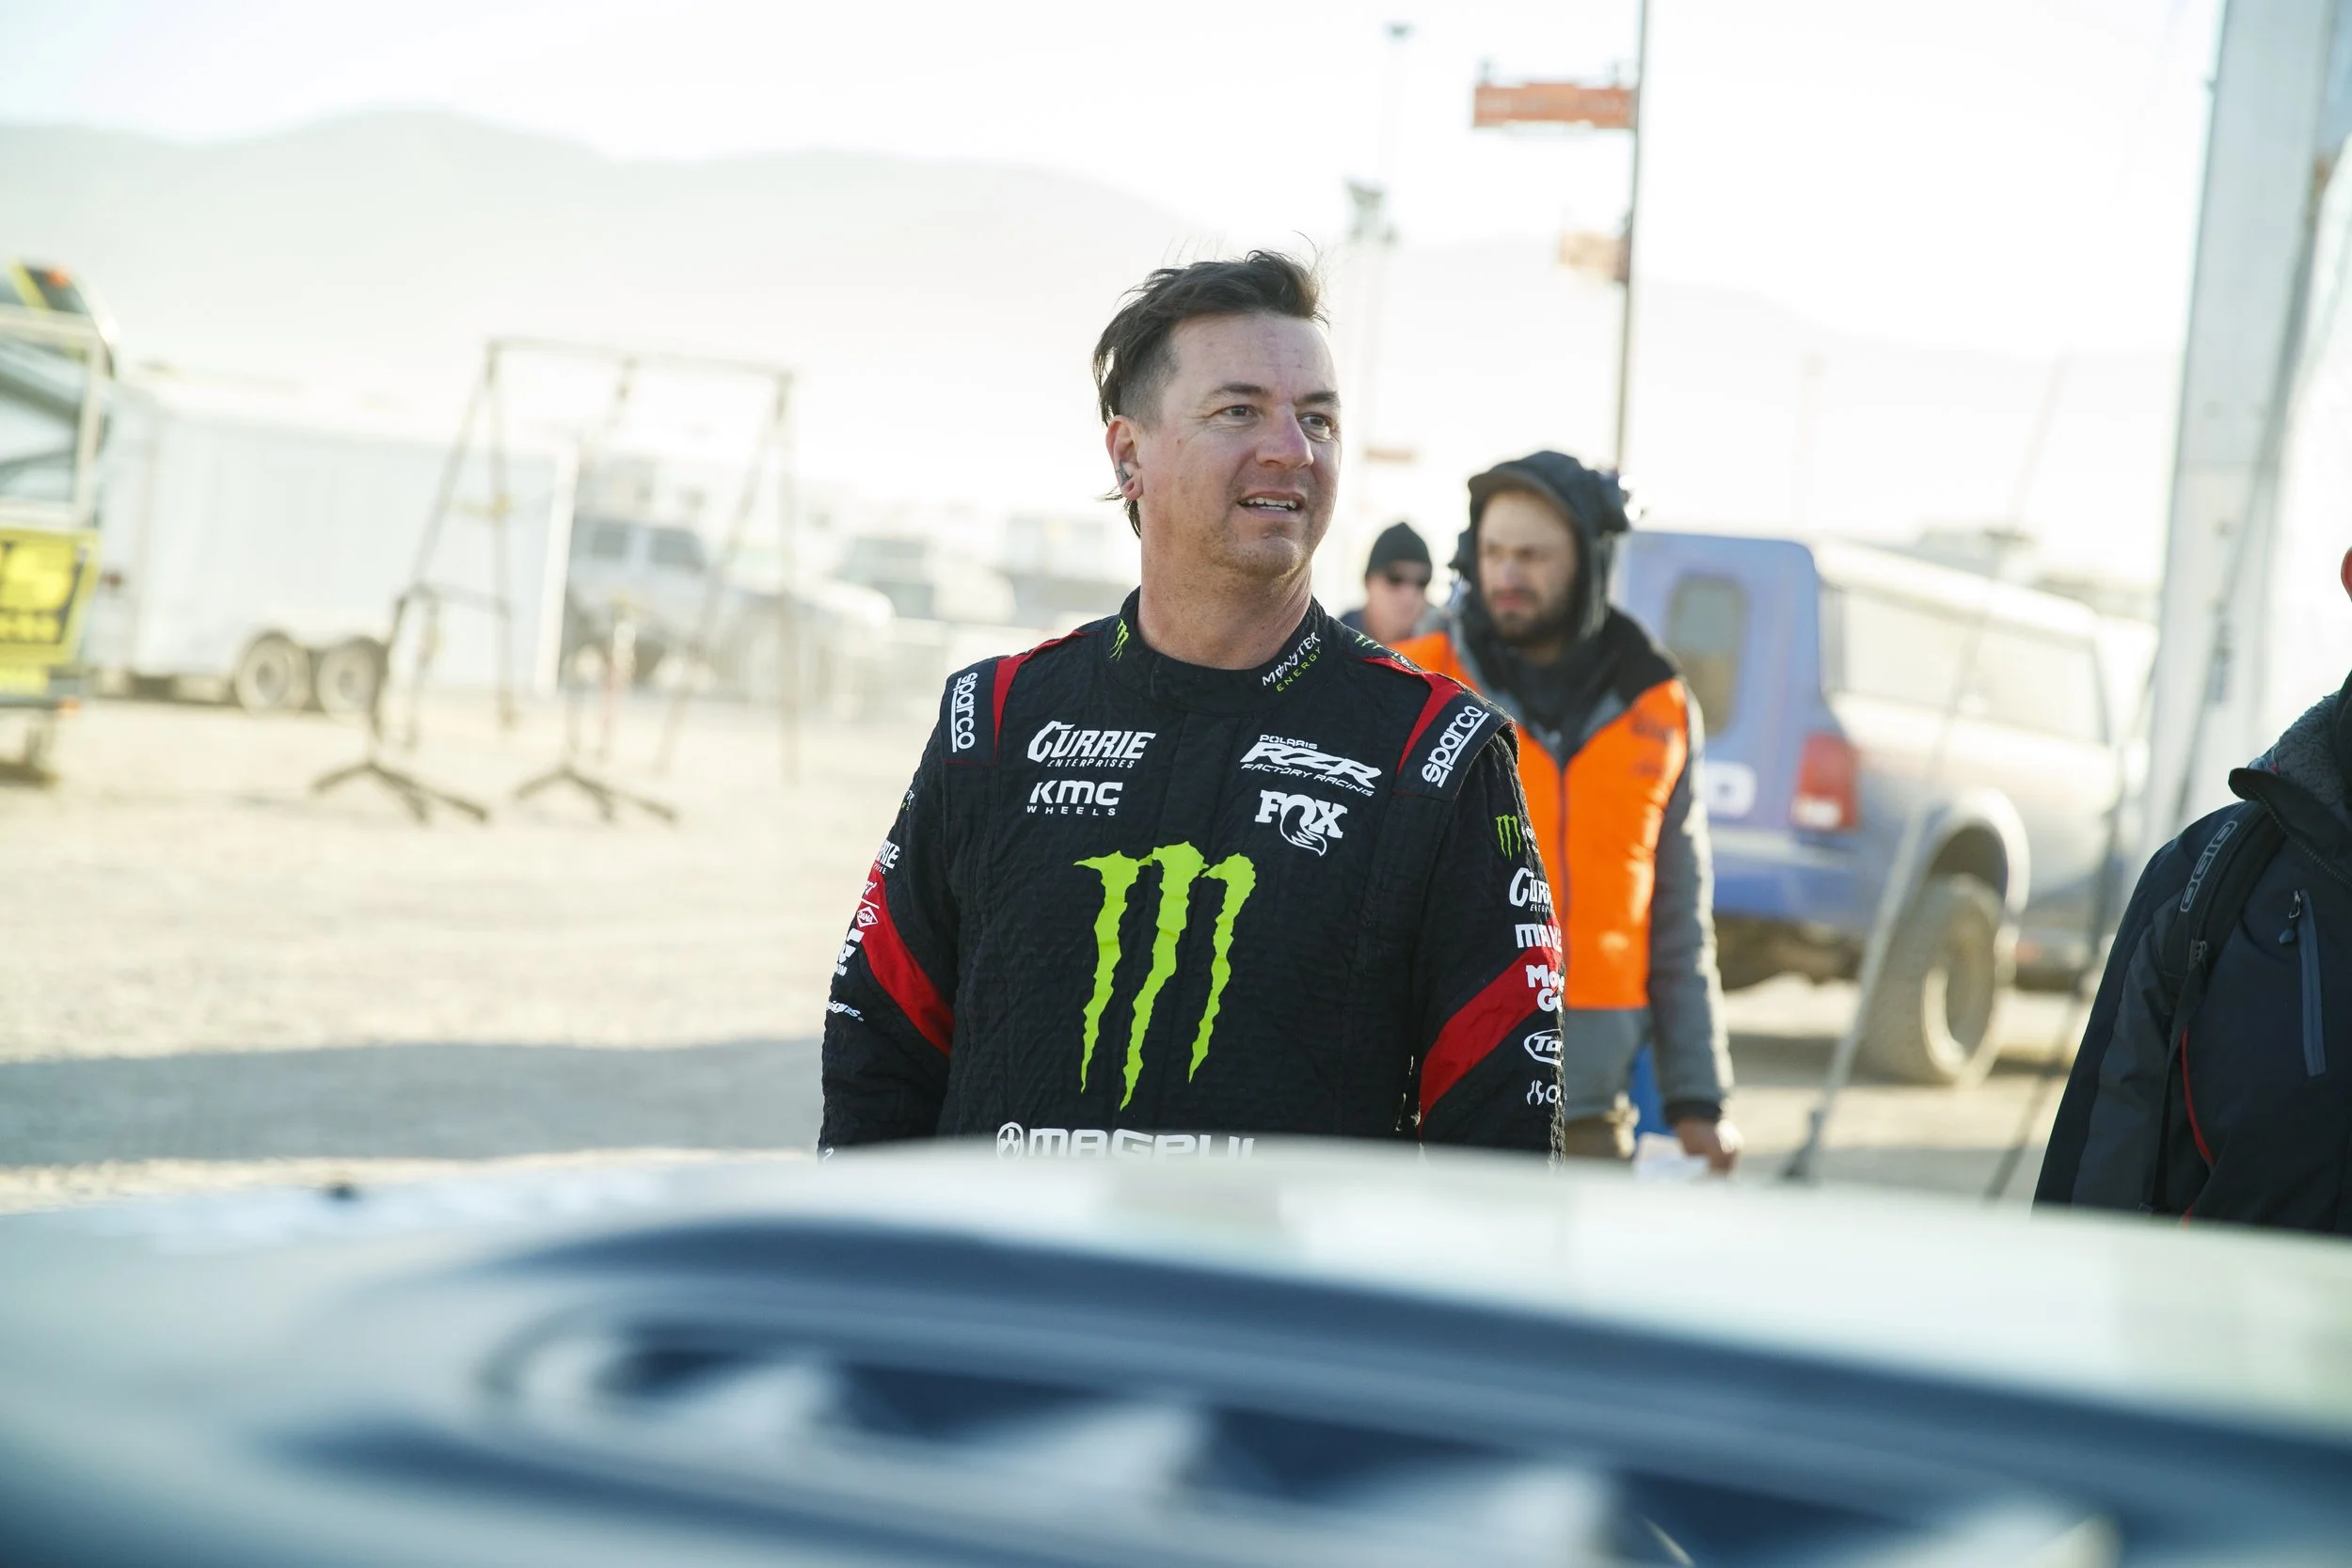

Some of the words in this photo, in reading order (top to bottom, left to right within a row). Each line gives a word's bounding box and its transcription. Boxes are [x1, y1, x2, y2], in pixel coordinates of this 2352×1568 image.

[1262, 631, 1321, 687] MONSTER
[1277, 646, 1322, 692] ENERGY
[951, 672, 978, 752] sparco
[1027, 720, 1157, 764] CURRIE
[1047, 759, 1136, 769] ENTERPRISES
[1259, 734, 1318, 750] POLARIS
[1422, 705, 1490, 788] sparco
[1239, 741, 1382, 789] RZR
[1241, 763, 1313, 778] FACTORY
[1313, 773, 1375, 797] RACING
[1026, 805, 1117, 816] WHEELS
[1029, 779, 1123, 806] KMC
[1254, 789, 1348, 857] FOX
